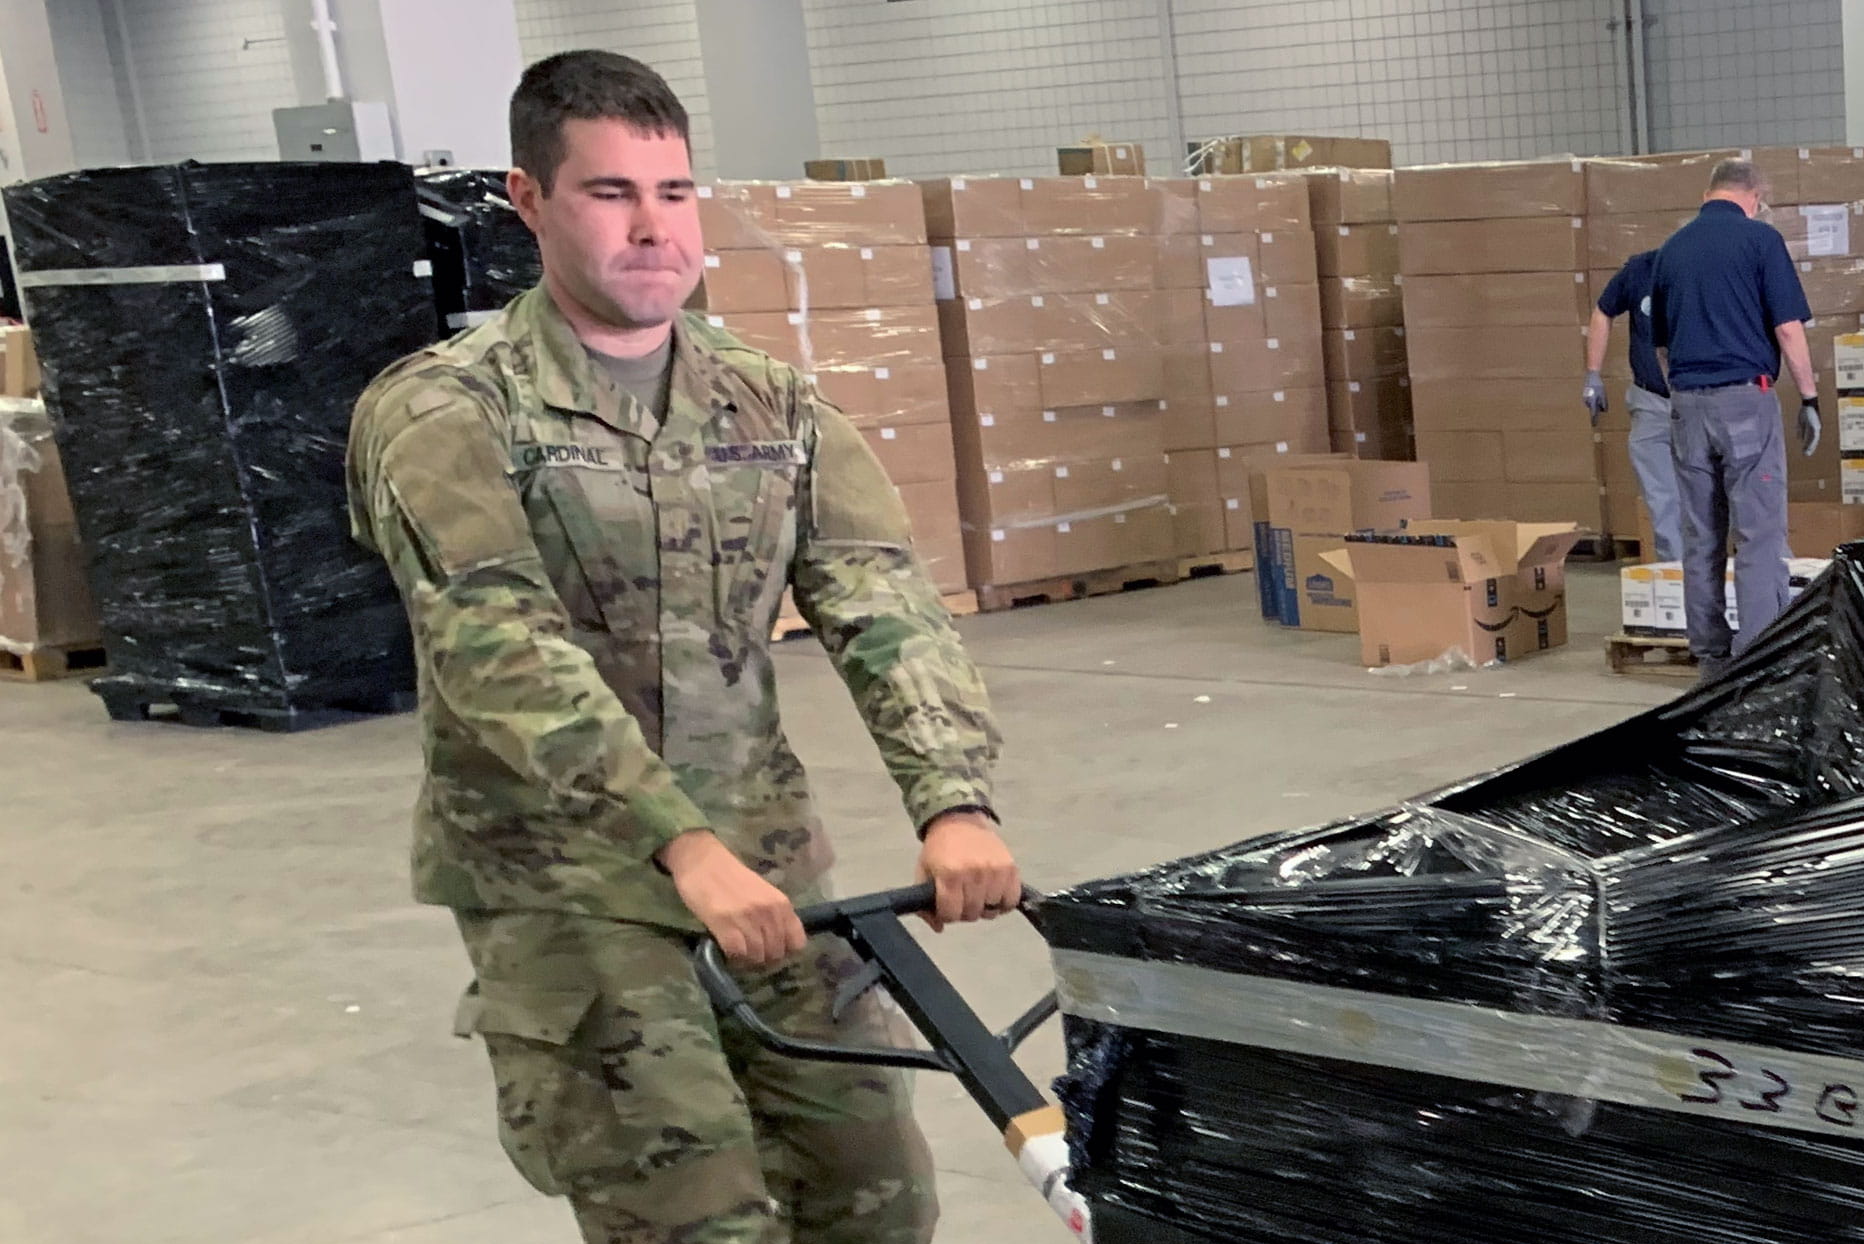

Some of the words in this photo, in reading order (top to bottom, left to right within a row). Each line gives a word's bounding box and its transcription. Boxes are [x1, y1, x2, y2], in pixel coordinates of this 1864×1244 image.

[523, 444, 608, 466] CARDINAL
[750, 443, 794, 461] ARMY
[1680, 1047, 1789, 1113] 33
